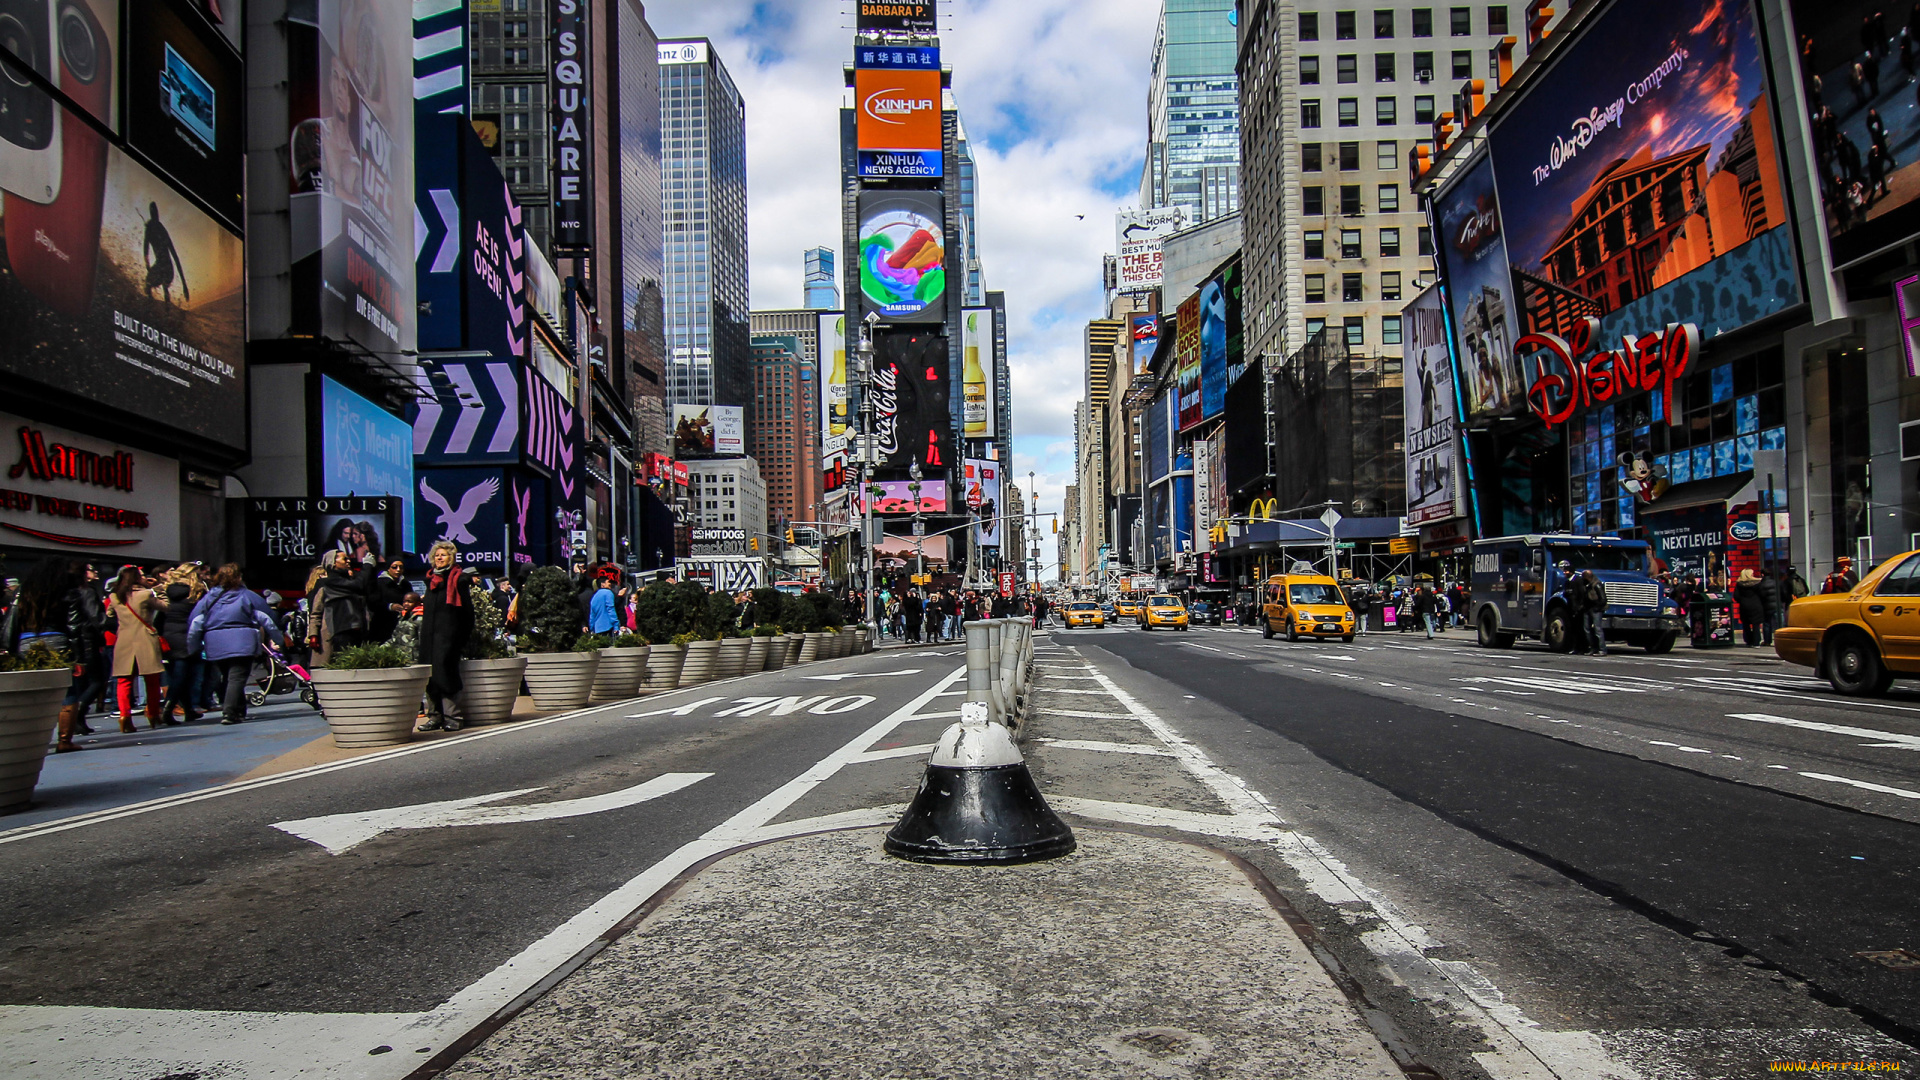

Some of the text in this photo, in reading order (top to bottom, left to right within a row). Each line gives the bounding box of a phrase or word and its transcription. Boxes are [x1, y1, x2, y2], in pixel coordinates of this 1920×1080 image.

[862, 5, 926, 16] BARBARA P.
[863, 51, 932, 64] 新华通讯社
[555, 32, 582, 200] SQUARE
[874, 99, 933, 110] XINHUA
[361, 101, 393, 182] FOX
[1532, 164, 1550, 186] The
[1550, 136, 1577, 171] Walt
[1571, 97, 1624, 149] Disney
[865, 166, 936, 174] NEWS AGENCY
[876, 154, 925, 165] XINHUA
[363, 158, 393, 215] UFC
[476, 220, 500, 267] AE IS
[1122, 245, 1144, 254] BEST
[347, 247, 378, 301] APRIL
[379, 276, 391, 313] 20
[474, 249, 502, 300] OPEN!
[1123, 273, 1144, 283] THIS
[885, 304, 922, 312] SAMSUNG
[1178, 296, 1198, 327] THE
[1179, 321, 1198, 340] CROWD
[1179, 330, 1199, 354] GOES
[114, 309, 236, 379] BUILT FOR THE WAY YOU PLAY.
[1180, 346, 1199, 371] WILD!
[1514, 316, 1695, 430] Disney
[725, 408, 733, 416] By
[364, 419, 401, 466] Merrill
[1410, 420, 1453, 453] NEWSIES
[8, 426, 135, 492] Marriott
[365, 463, 393, 492] Wealth
[34, 494, 82, 519] YORK
[83, 502, 149, 529] MARQUIS
[255, 500, 387, 512] MARQUIS
[260, 519, 308, 543] Jekyll
[704, 529, 720, 539] HOT
[721, 529, 745, 539] DOGS
[1662, 531, 1722, 550] NEXT LEVEL!
[1732, 525, 1757, 536] Disney
[266, 537, 316, 562] Hyde
[466, 551, 501, 563] OPEN
[1475, 554, 1499, 573] GARDA
[1002, 573, 1012, 591] tkts
